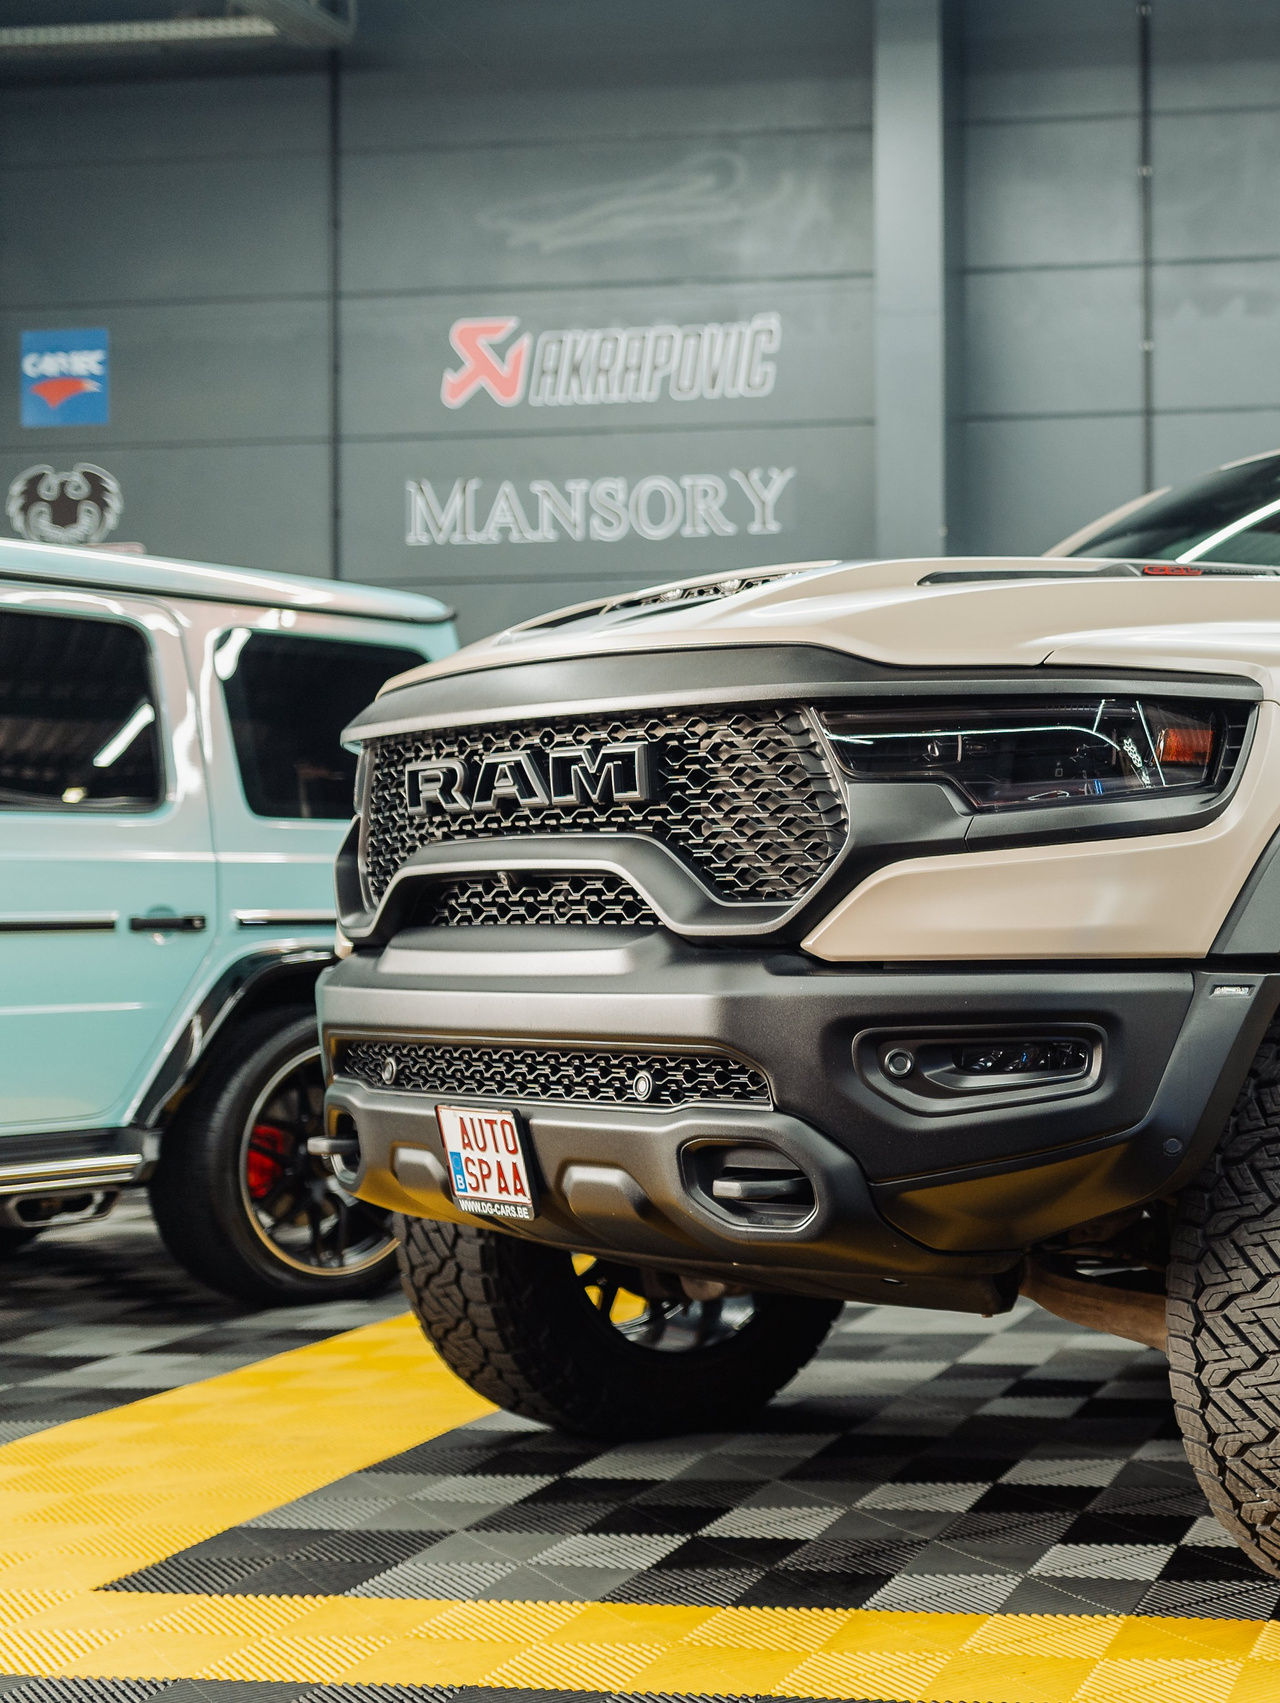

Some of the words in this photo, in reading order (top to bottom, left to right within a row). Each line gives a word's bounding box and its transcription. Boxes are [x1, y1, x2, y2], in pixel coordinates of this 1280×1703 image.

[405, 466, 797, 546] MANSORY
[405, 742, 652, 816] RAM
[459, 1116, 518, 1155] AUTO
[456, 1174, 466, 1190] B
[464, 1156, 527, 1197] SPAA
[459, 1199, 530, 1219] WWW.DG-CARS.BE
